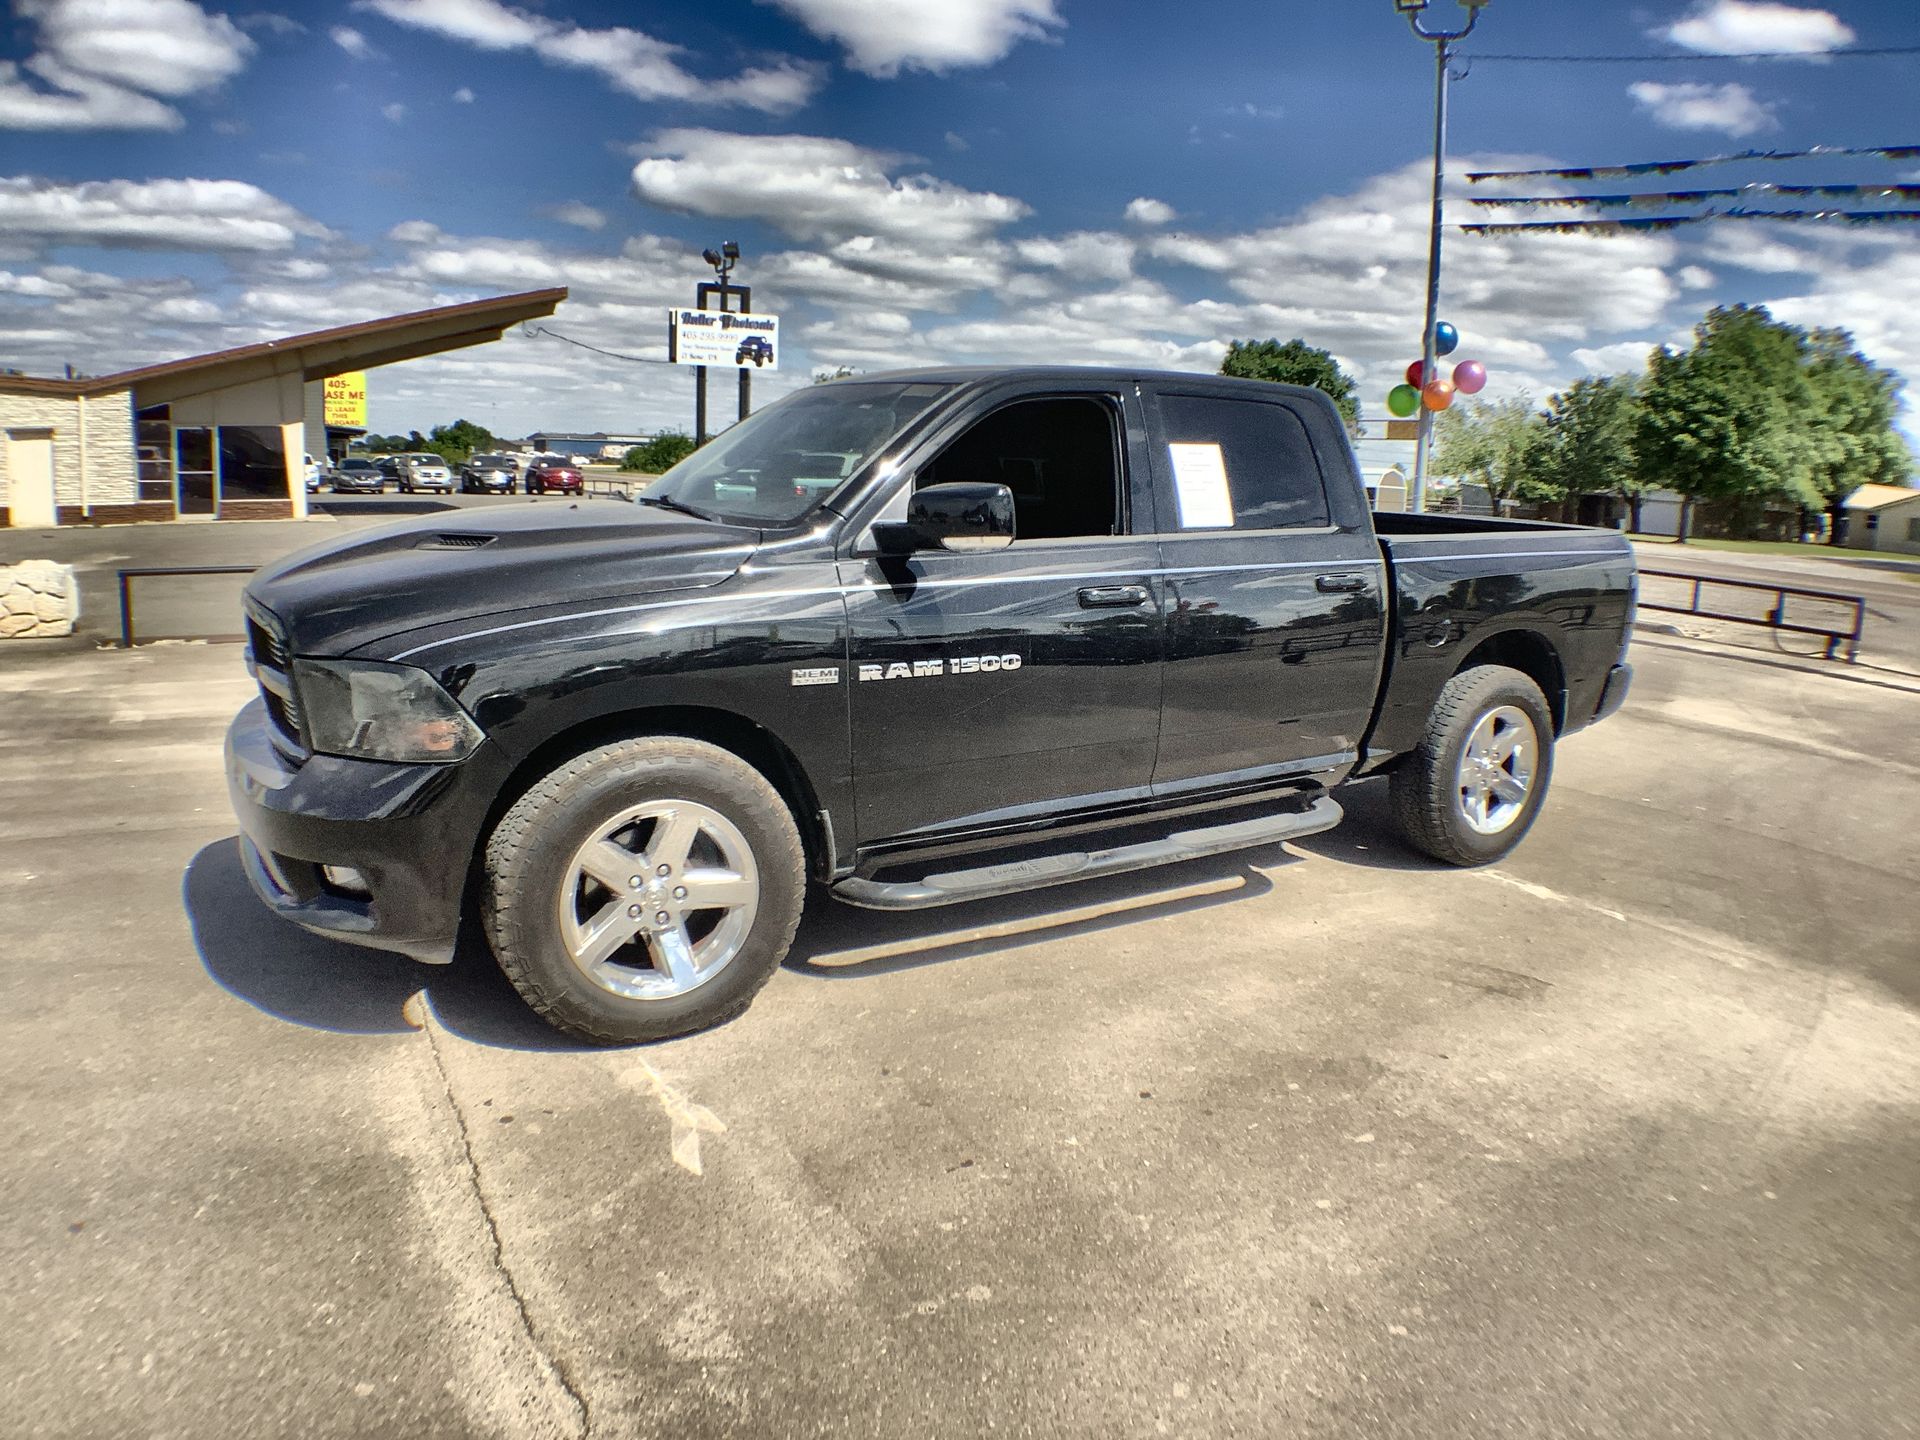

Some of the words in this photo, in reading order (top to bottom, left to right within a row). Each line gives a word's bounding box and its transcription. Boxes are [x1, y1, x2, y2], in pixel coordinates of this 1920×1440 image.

[348, 391, 365, 400] ME
[858, 659, 944, 682] RAM
[949, 653, 1022, 674] 1500
[795, 669, 838, 678] HEMI
